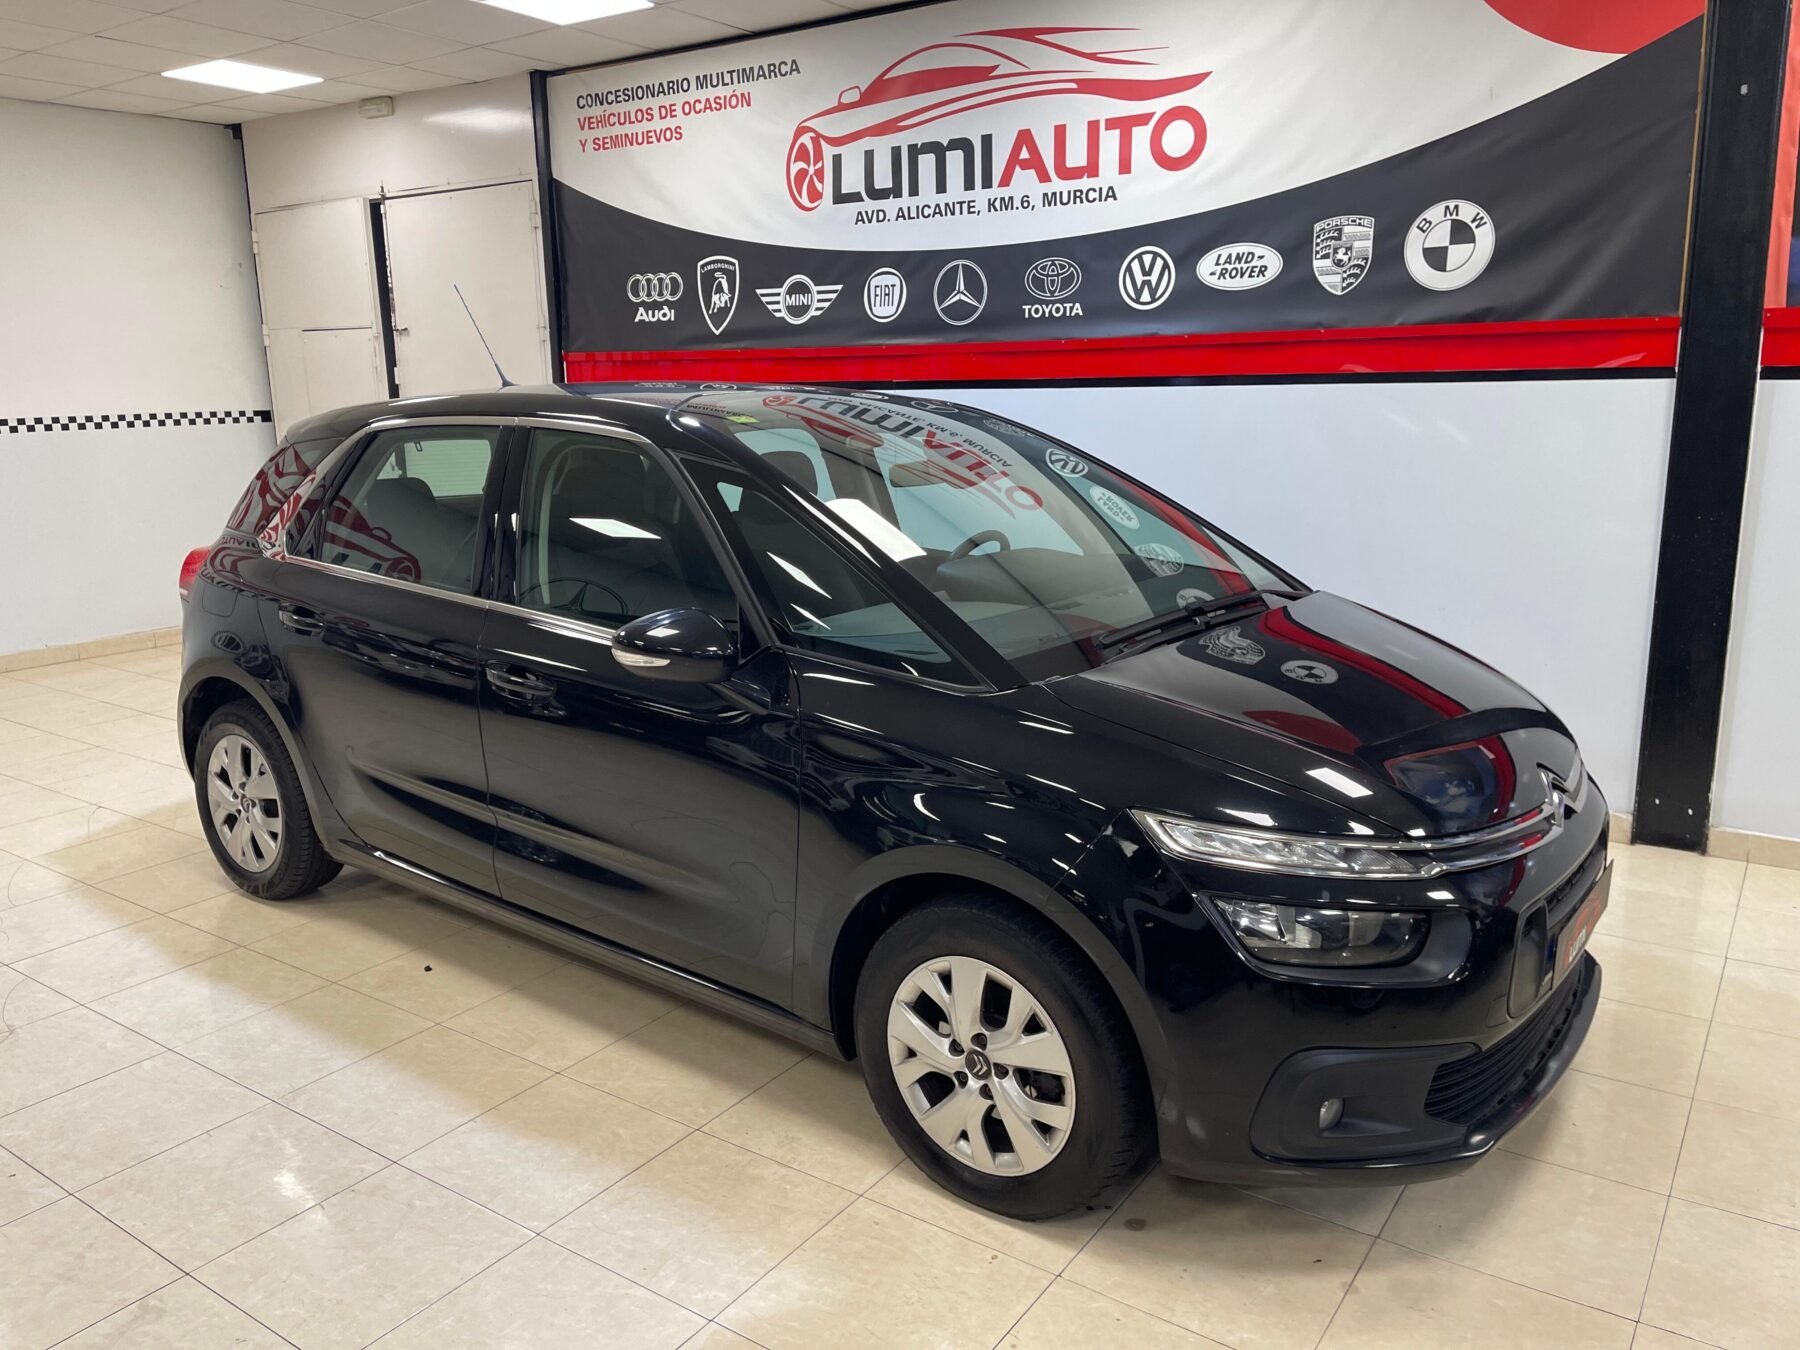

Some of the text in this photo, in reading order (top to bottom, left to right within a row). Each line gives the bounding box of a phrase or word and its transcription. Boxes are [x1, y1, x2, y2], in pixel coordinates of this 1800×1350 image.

[576, 58, 801, 110] CONCESIONARIO MULTIMARCA
[577, 90, 752, 132] VEHÍCULOS DE OCASIÓN
[579, 125, 684, 153] Y SEMINUEVOS
[854, 185, 1118, 226] AVD. ALICANTE, KM.6, MURCIA
[1416, 204, 1488, 234] BMW
[1316, 217, 1373, 233] PORSCHE
[784, 292, 812, 308] MINI
[873, 282, 898, 308] FIAT
[634, 305, 675, 322] Audi
[1022, 302, 1084, 319] TOYOTA
